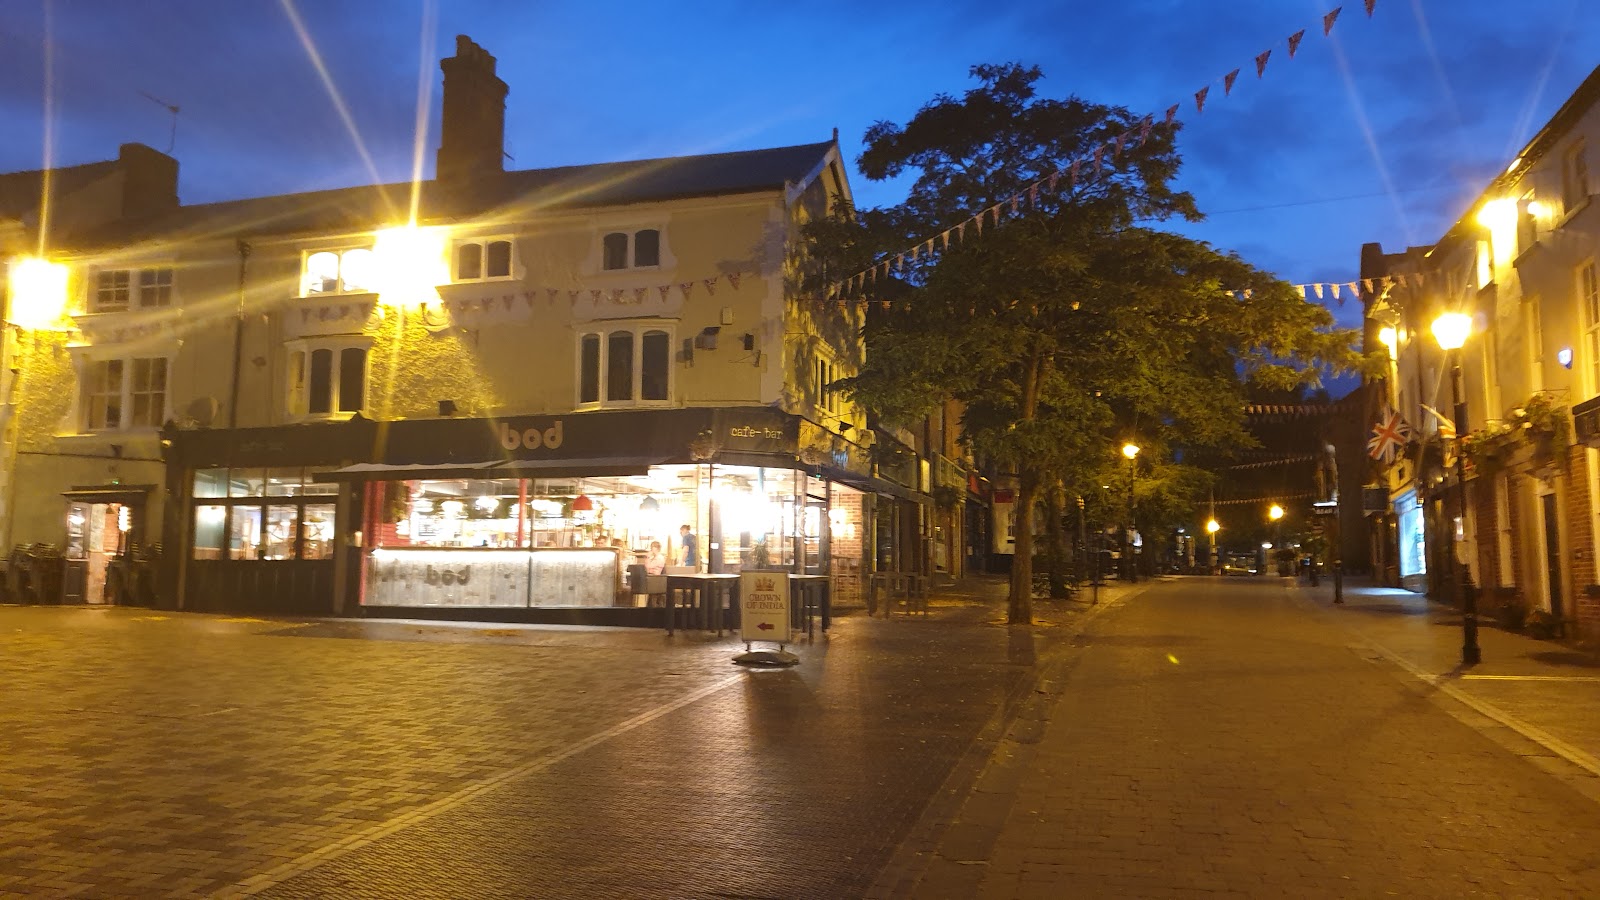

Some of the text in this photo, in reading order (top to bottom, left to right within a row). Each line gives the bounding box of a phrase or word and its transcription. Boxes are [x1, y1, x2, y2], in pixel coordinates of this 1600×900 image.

[501, 420, 563, 451] bod
[764, 427, 784, 440] bar
[426, 564, 471, 586] bod
[749, 593, 781, 602] CROWN
[746, 601, 786, 610] OF INDIA
